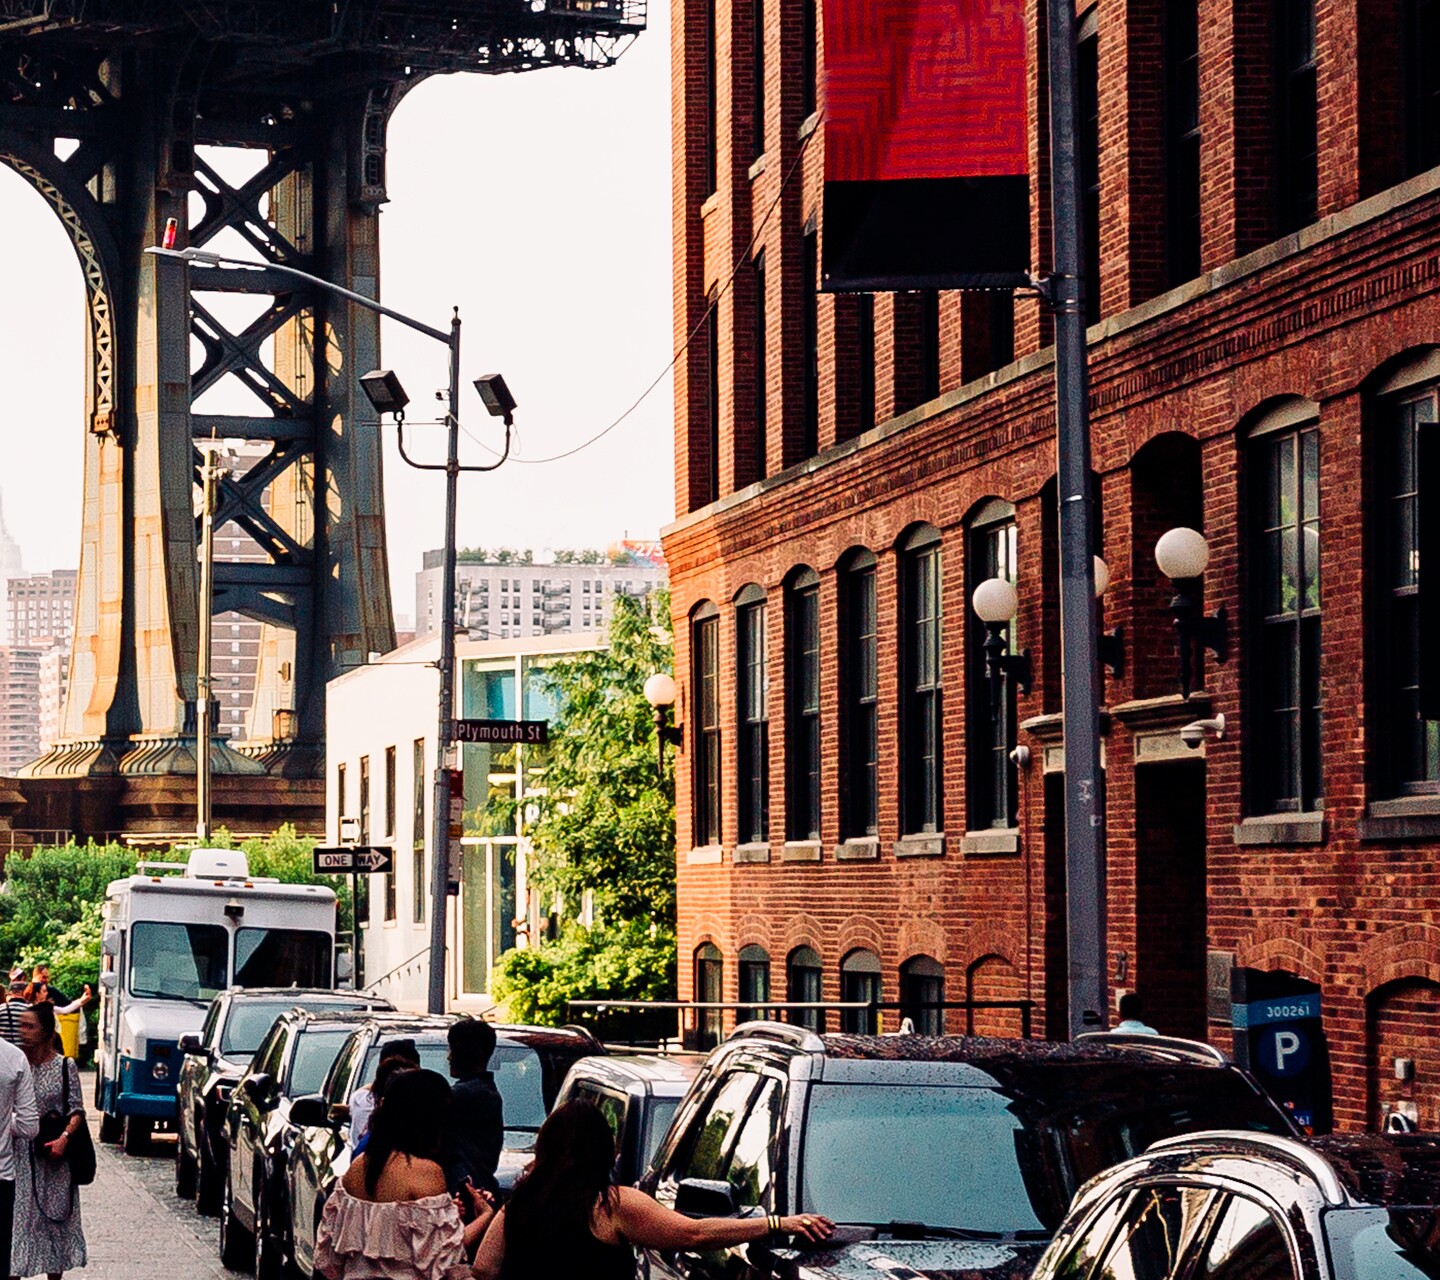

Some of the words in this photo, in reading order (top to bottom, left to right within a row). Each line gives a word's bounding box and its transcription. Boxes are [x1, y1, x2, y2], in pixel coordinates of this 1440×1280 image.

[458, 723, 523, 741] Plymouth
[527, 725, 540, 740] St
[324, 855, 348, 866] ONE
[358, 855, 380, 866] WAY
[1266, 1005, 1310, 1018] 300261
[1275, 1031, 1300, 1070] P
